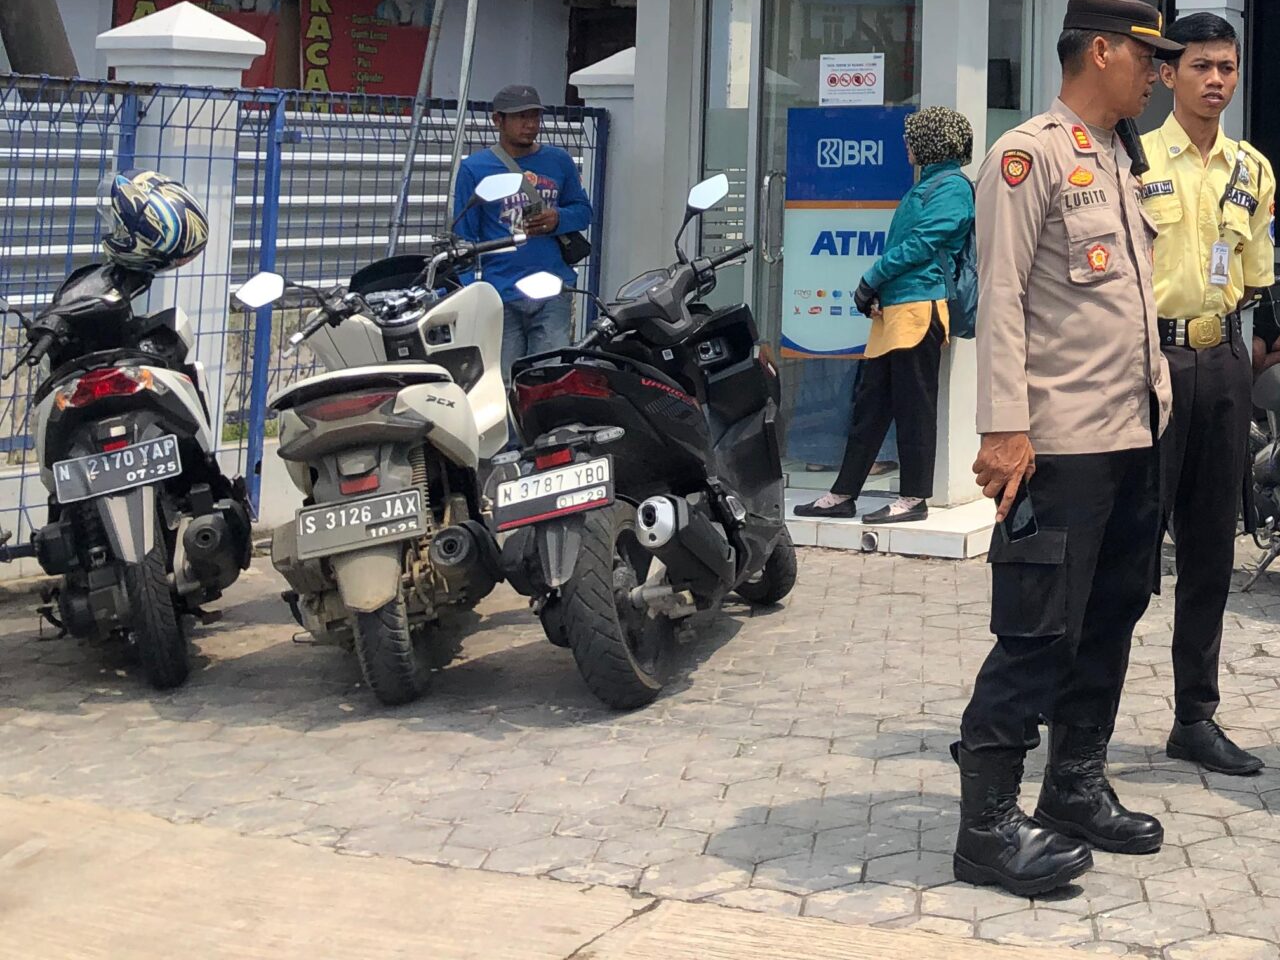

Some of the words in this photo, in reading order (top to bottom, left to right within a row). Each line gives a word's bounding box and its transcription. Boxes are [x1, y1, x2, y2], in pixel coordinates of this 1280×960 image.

[844, 140, 883, 165] BRI
[1064, 189, 1107, 211] LUGITO
[810, 231, 885, 256] ATM
[59, 465, 71, 481] N
[88, 450, 135, 476] 2170
[139, 440, 174, 465] YAP
[503, 487, 512, 503] N
[521, 474, 564, 499] 3787
[305, 516, 316, 534] S
[326, 506, 372, 529] 3126
[381, 497, 416, 518] JAX
